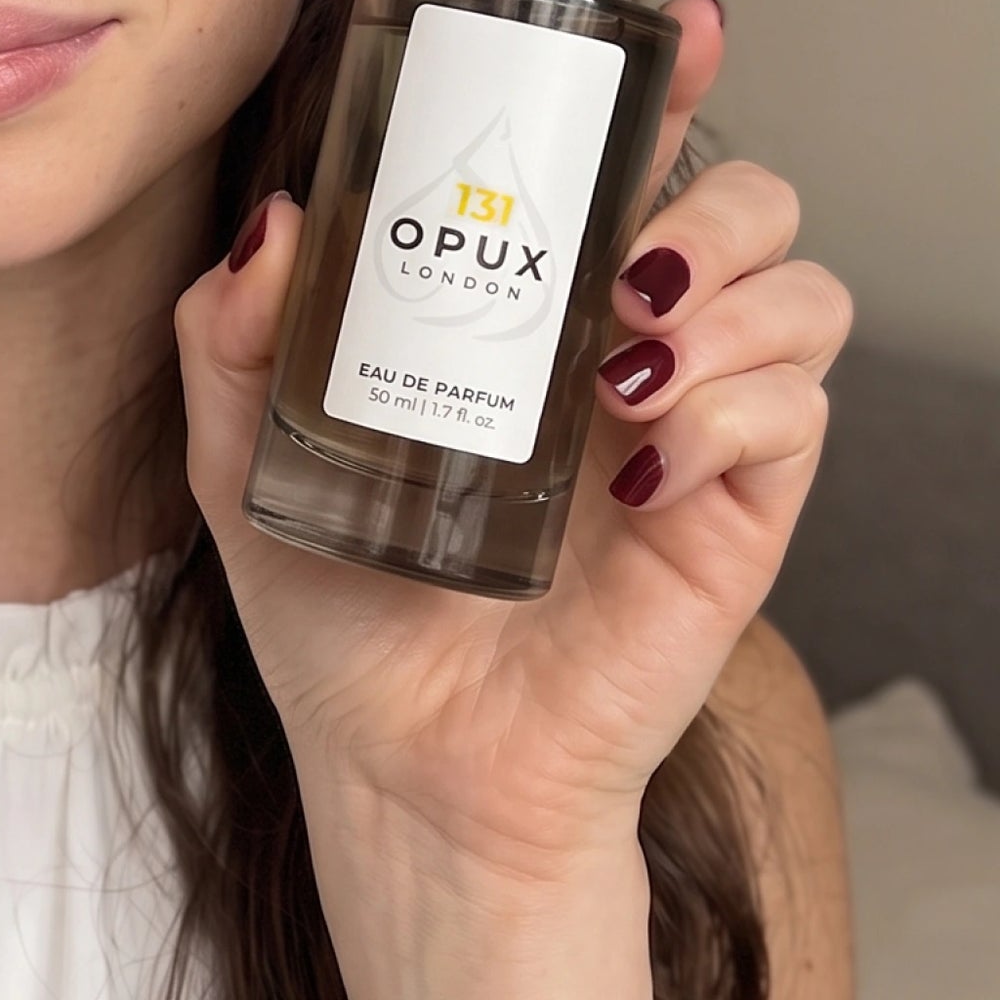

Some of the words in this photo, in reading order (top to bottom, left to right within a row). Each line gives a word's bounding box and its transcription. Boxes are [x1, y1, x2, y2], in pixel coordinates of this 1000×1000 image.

[456, 183, 515, 227] 131
[390, 217, 548, 281] OPUX
[401, 261, 520, 300] LONDON
[359, 362, 397, 383] EAU
[403, 373, 429, 391] DE
[435, 382, 515, 411] PARFUM
[369, 387, 391, 403] 50
[394, 394, 417, 410] ml
[432, 402, 452, 418] 1.7
[456, 408, 470, 423] fl.
